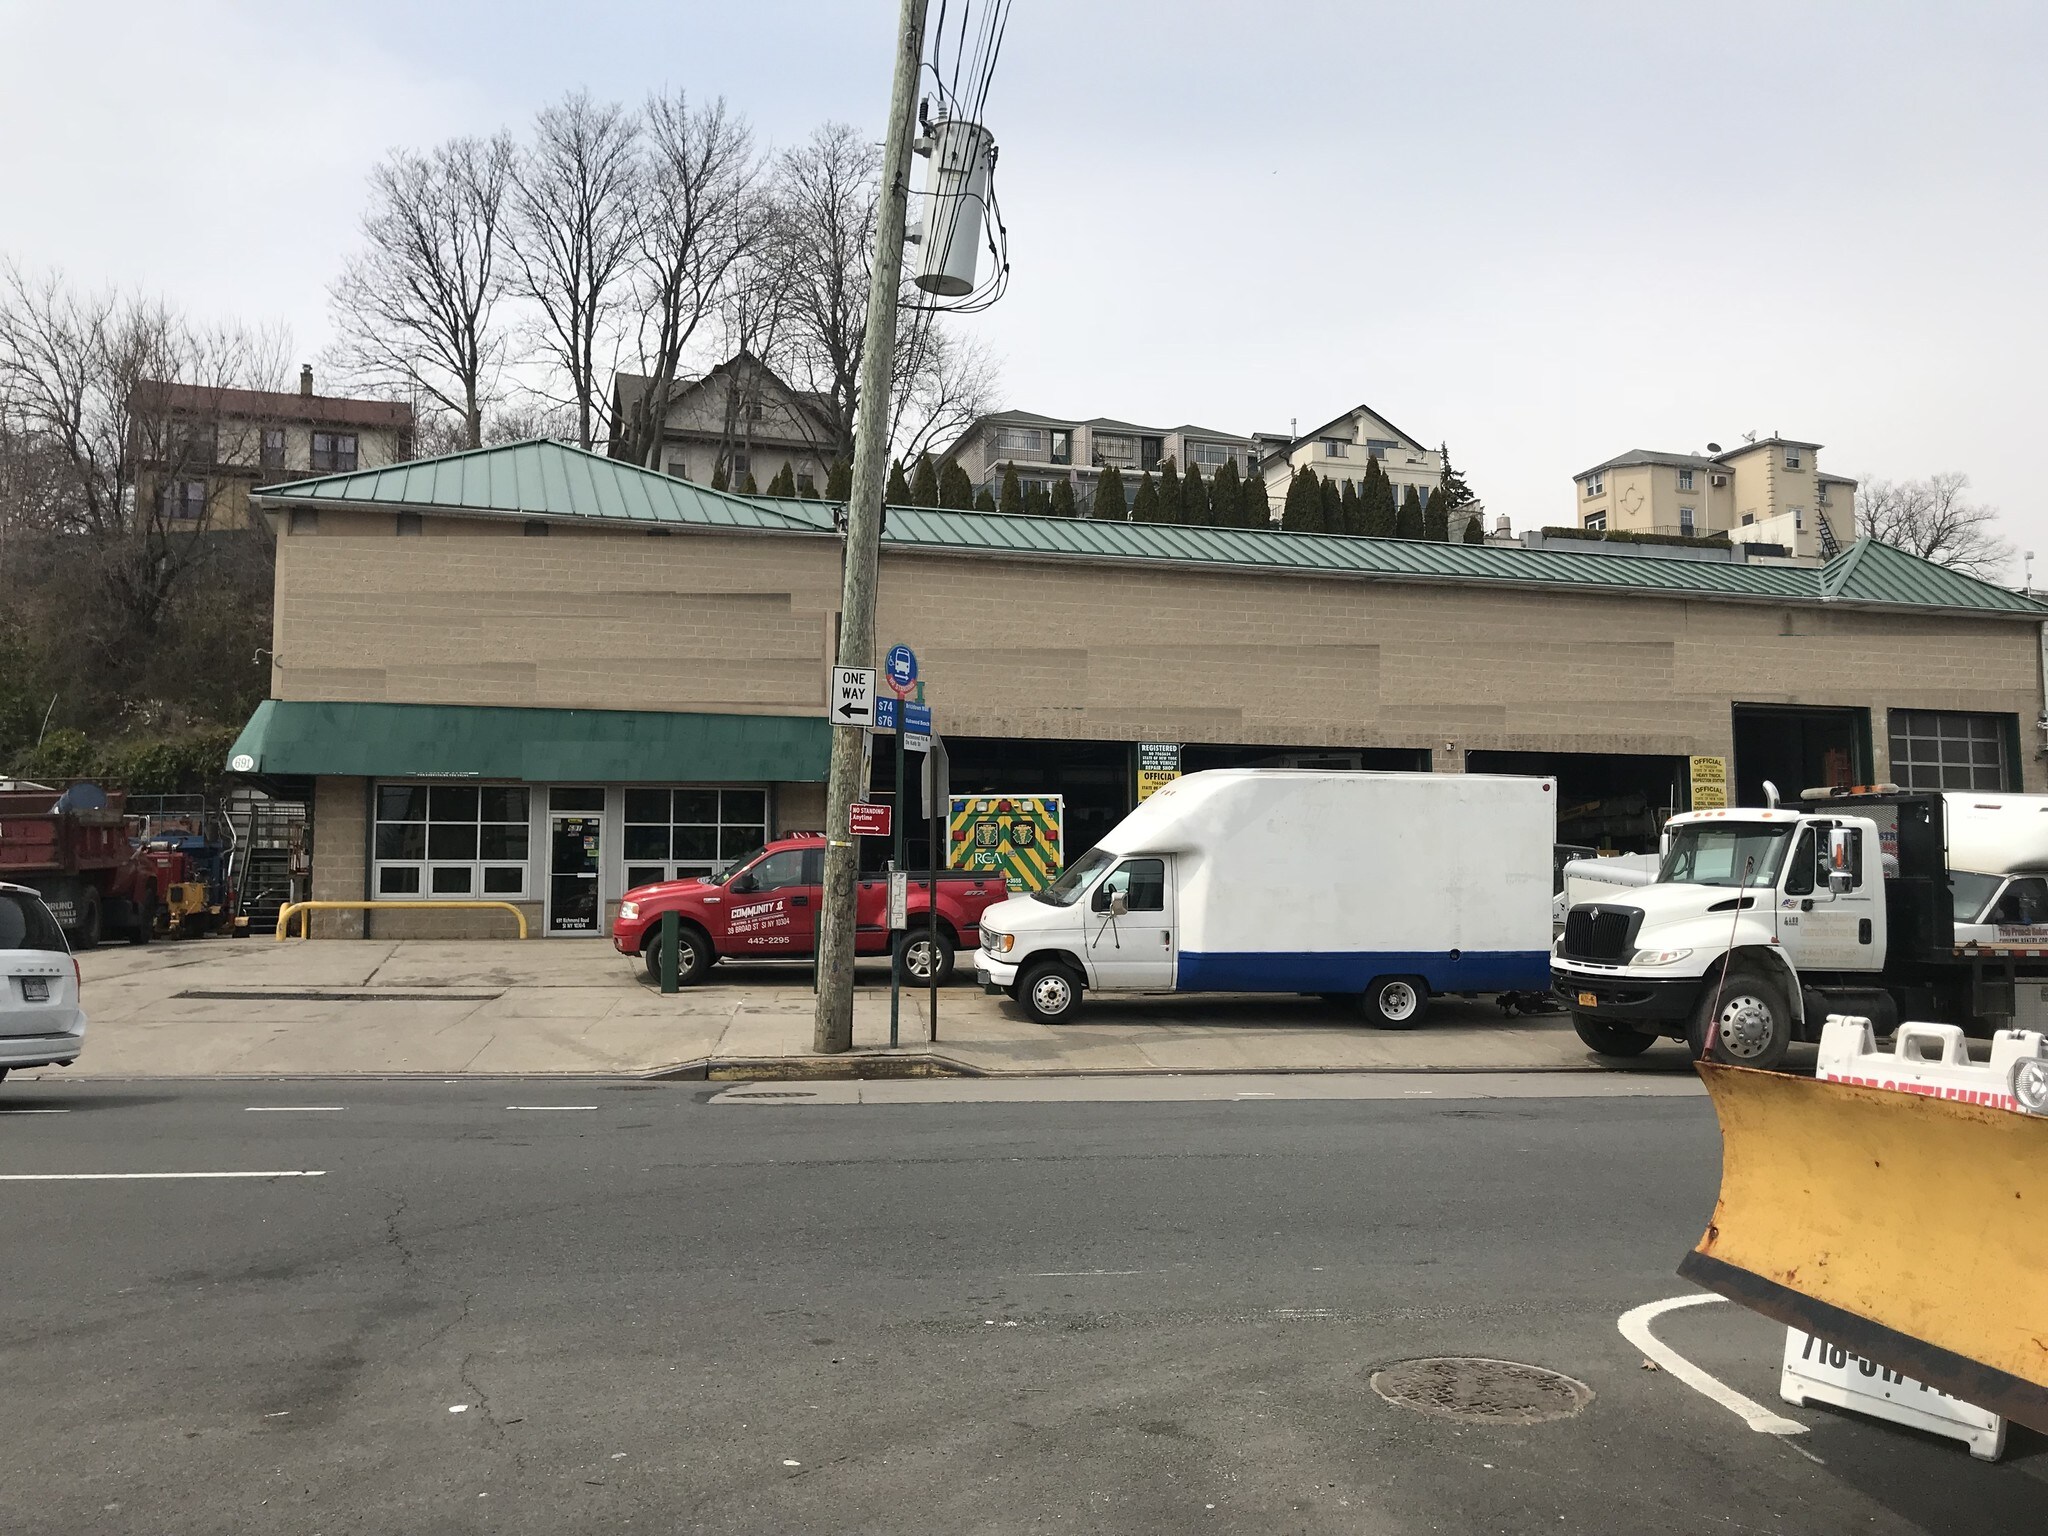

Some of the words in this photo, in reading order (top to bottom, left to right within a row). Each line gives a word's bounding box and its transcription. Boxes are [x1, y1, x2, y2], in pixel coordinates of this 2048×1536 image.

[843, 672, 866, 685] ONE
[842, 687, 865, 700] WAY
[878, 700, 893, 712] S74
[878, 715, 893, 727] S76
[235, 757, 250, 769] 691
[1694, 758, 1721, 766] OFFICIAL
[1695, 786, 1723, 795] OFFICIAL
[852, 813, 873, 821] Anytime
[975, 852, 1002, 864] RCA
[731, 903, 774, 919] COMMUNITY
[727, 927, 735, 935] 39
[735, 924, 752, 934] BROAD
[752, 922, 760, 931] ST
[767, 920, 775, 928] NY
